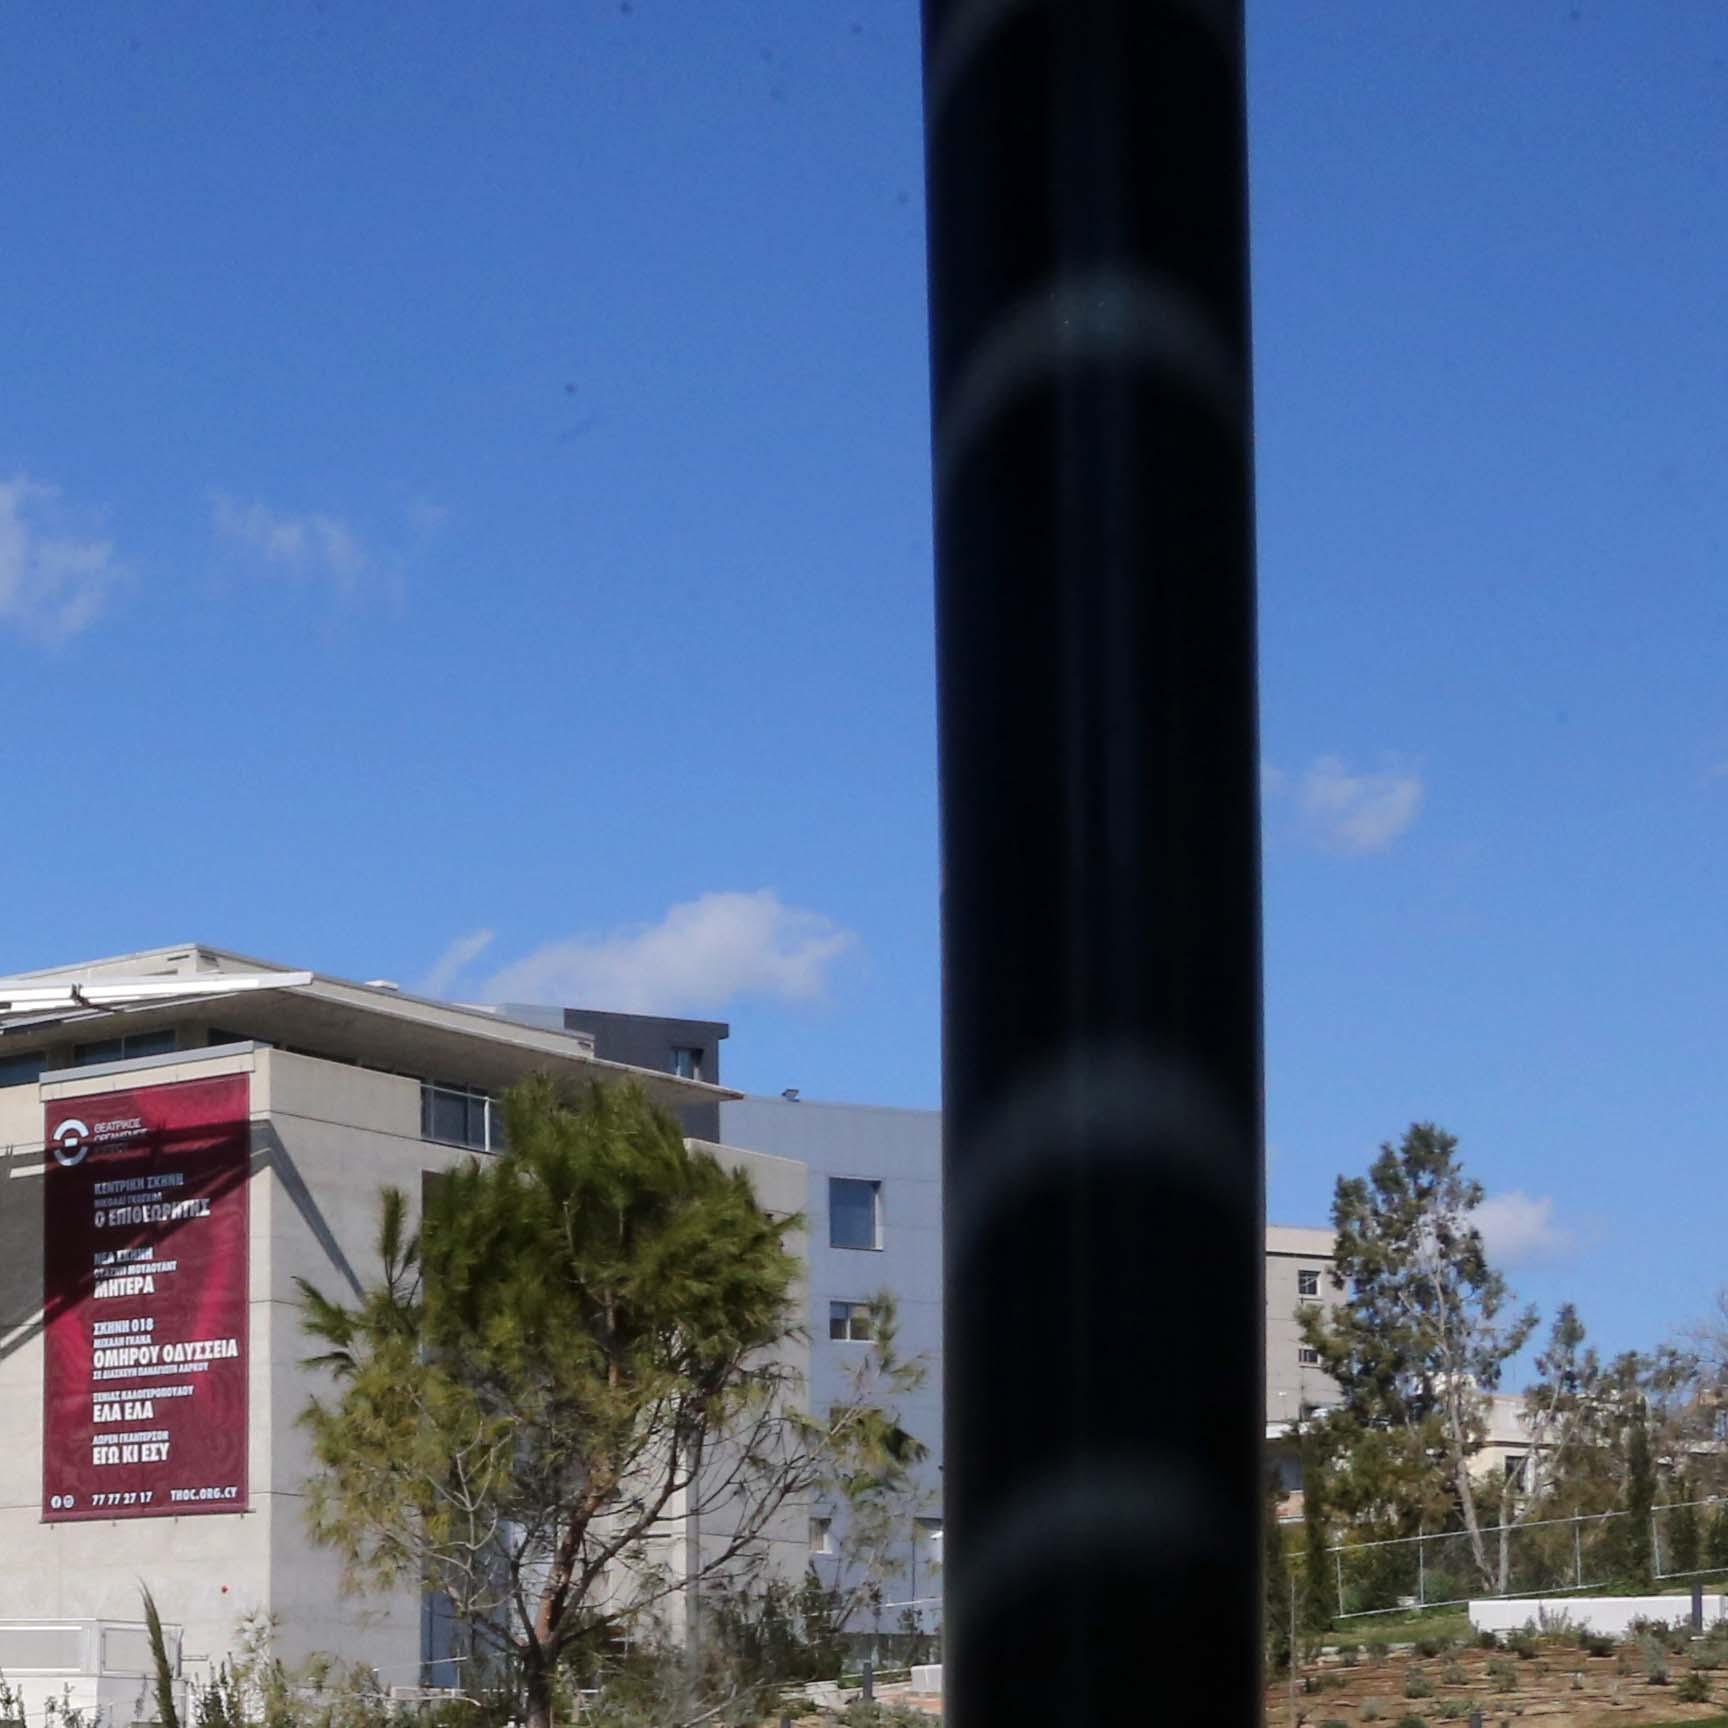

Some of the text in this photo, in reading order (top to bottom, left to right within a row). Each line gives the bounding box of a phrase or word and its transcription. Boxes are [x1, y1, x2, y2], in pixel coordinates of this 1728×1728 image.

[95, 1199, 211, 1228] Ο ΕΠΙΘΕΩΡΗΤΗΣ
[94, 1275, 155, 1298] ΜΗΤΕΡΑ
[93, 1318, 154, 1335] ΣΚΗΝΗ 018
[94, 1339, 239, 1368] ΟΜΗΡΟΥ ΟΔΥΣΣΕΙΑ
[93, 1401, 154, 1423] ΕΛΑ ΕΛΑ
[93, 1442, 170, 1465] ΕΓΩ ΚΙ ΕΣΥ
[170, 1487, 238, 1501] THOC.ORG.CY
